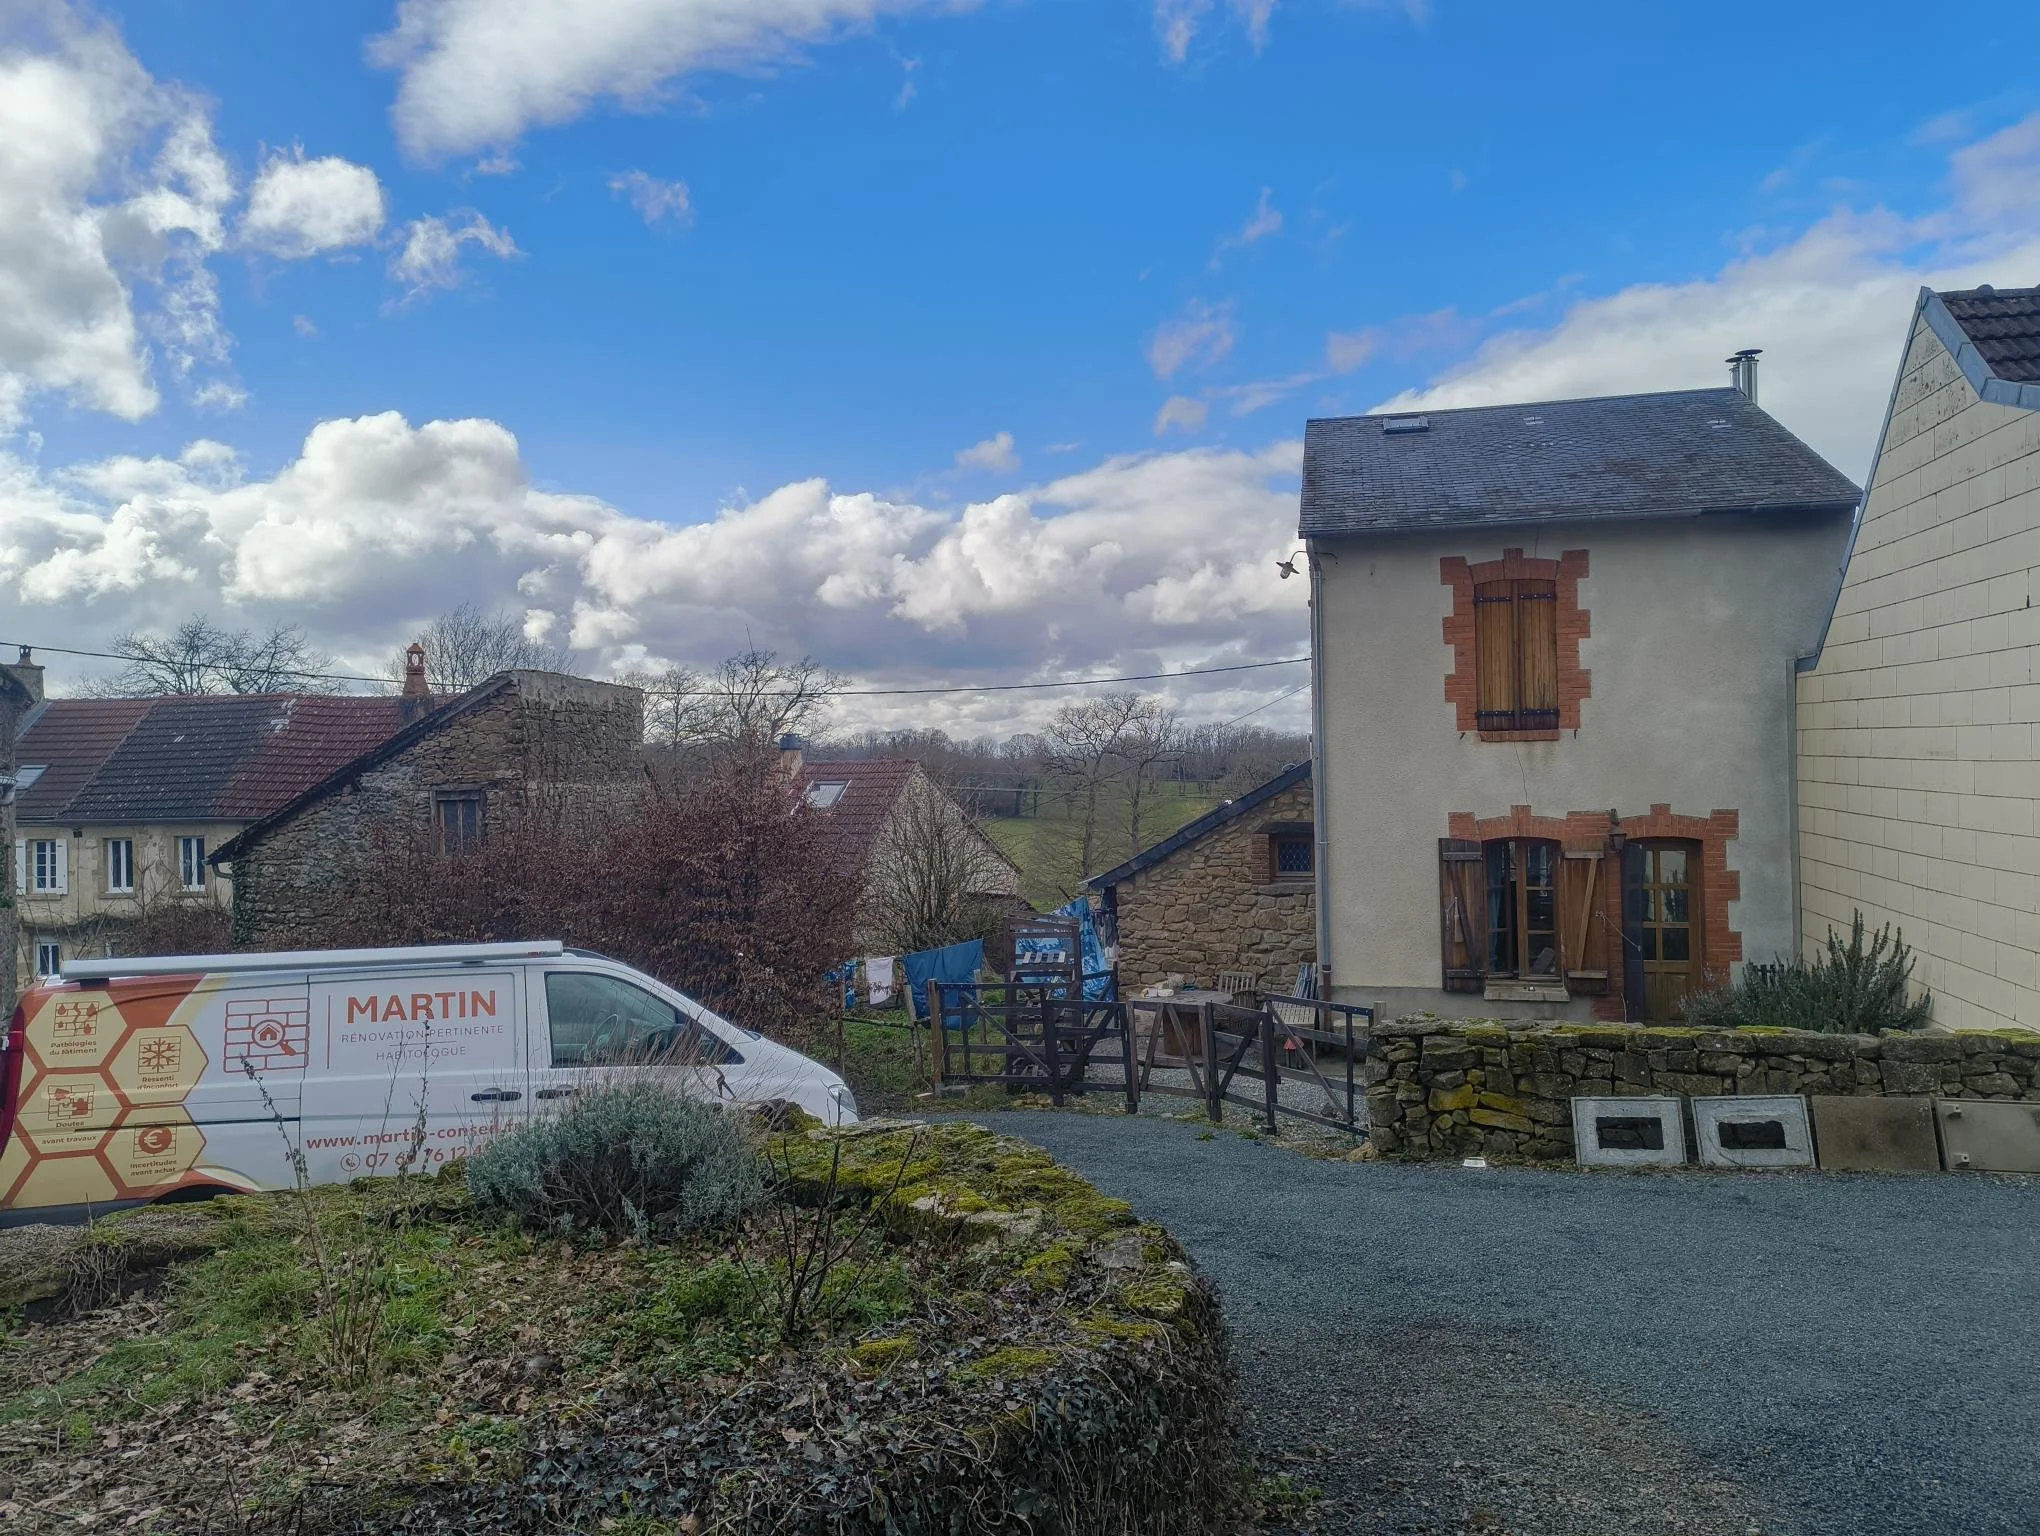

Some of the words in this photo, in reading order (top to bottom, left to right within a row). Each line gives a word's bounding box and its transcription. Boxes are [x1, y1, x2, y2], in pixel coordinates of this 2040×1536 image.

[348, 990, 496, 1024] MARTIN
[341, 1029, 425, 1043] RÉNOVATION
[429, 1025, 504, 1038] PERTINENTE
[50, 1040, 97, 1048] Pathologies
[376, 1046, 467, 1061] HABITOLOGUE
[142, 1075, 175, 1083] Ressenti
[56, 1120, 85, 1128] Doutes
[41, 1137, 65, 1145] avant
[66, 1135, 97, 1143] travaux
[130, 1159, 177, 1169] Incertitudes
[366, 1152, 389, 1168] 07
[130, 1169, 153, 1177] avant
[154, 1167, 176, 1175] achat
